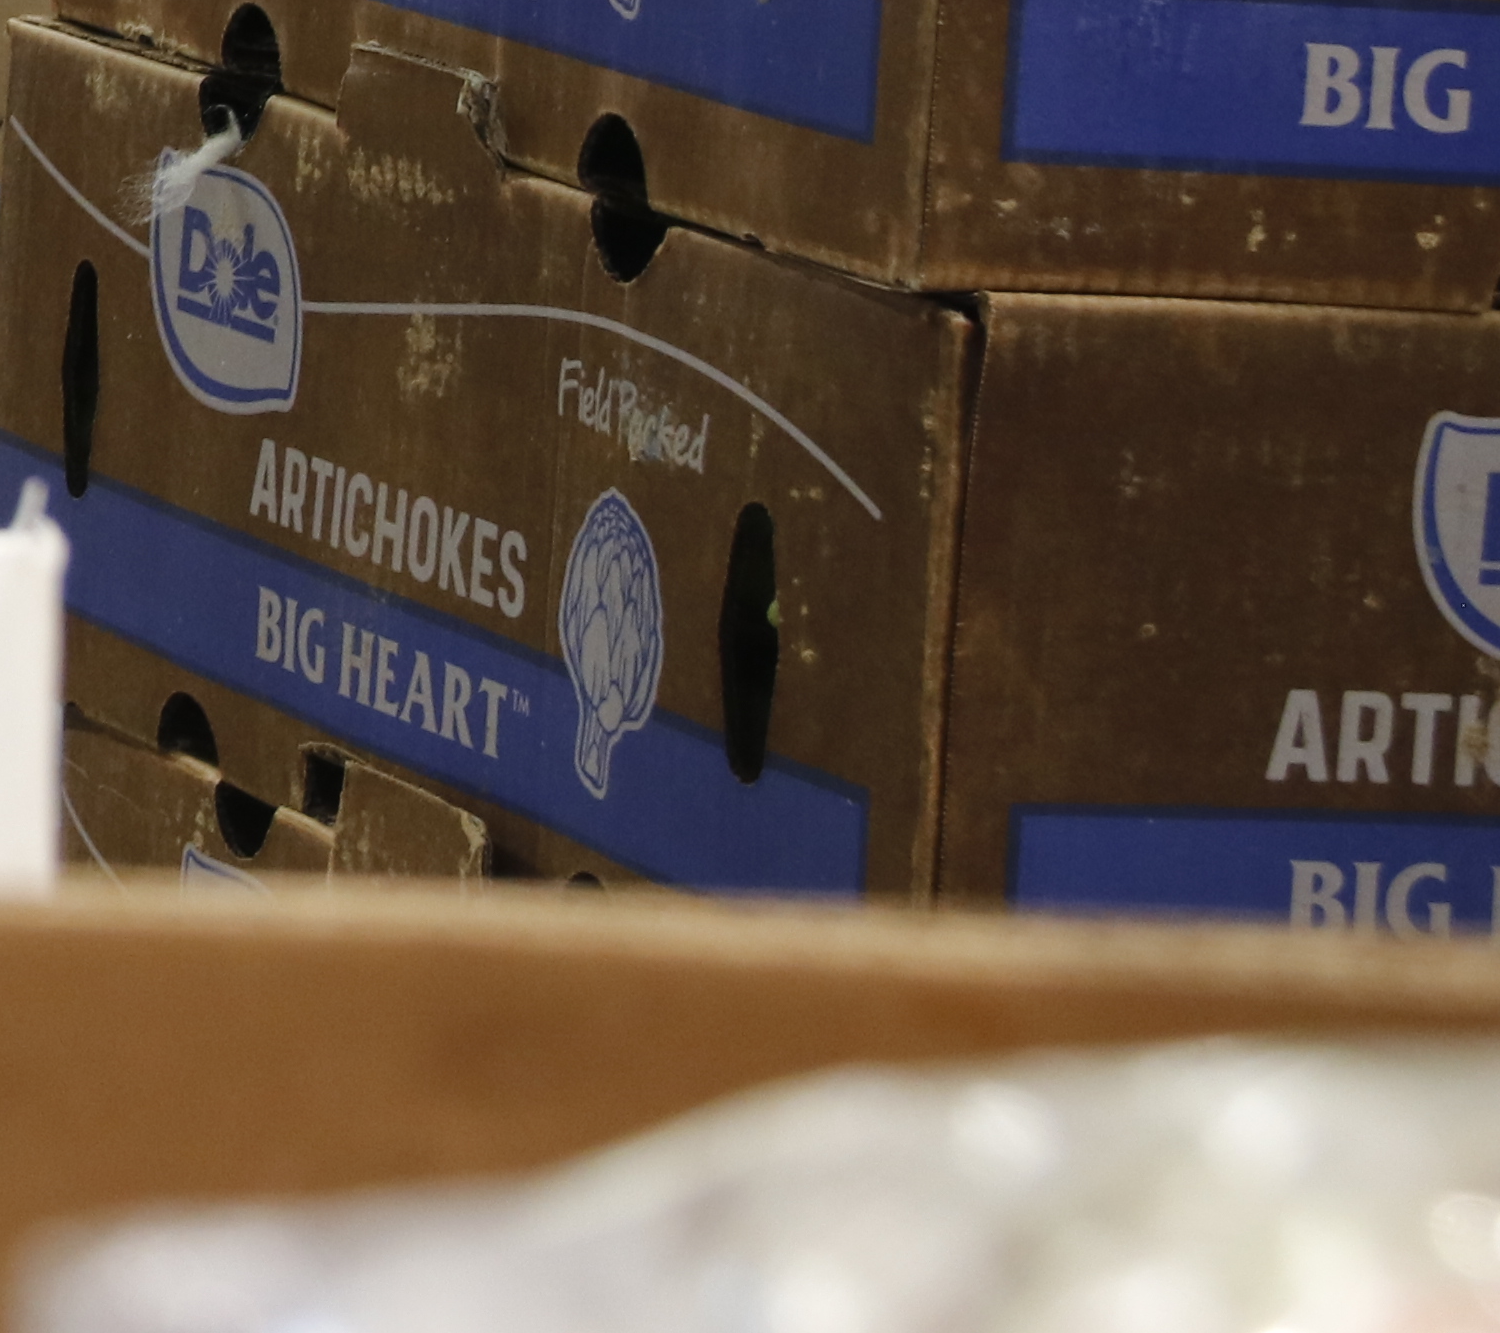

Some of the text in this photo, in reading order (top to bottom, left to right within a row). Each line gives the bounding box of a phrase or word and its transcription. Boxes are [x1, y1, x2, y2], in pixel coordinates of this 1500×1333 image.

[1299, 41, 1473, 134] BIG
[179, 205, 281, 321] Dole
[558, 357, 616, 438] Field
[249, 437, 529, 620] ARTICHOKES
[254, 584, 326, 685] BIG
[1287, 858, 1454, 935] BIG
